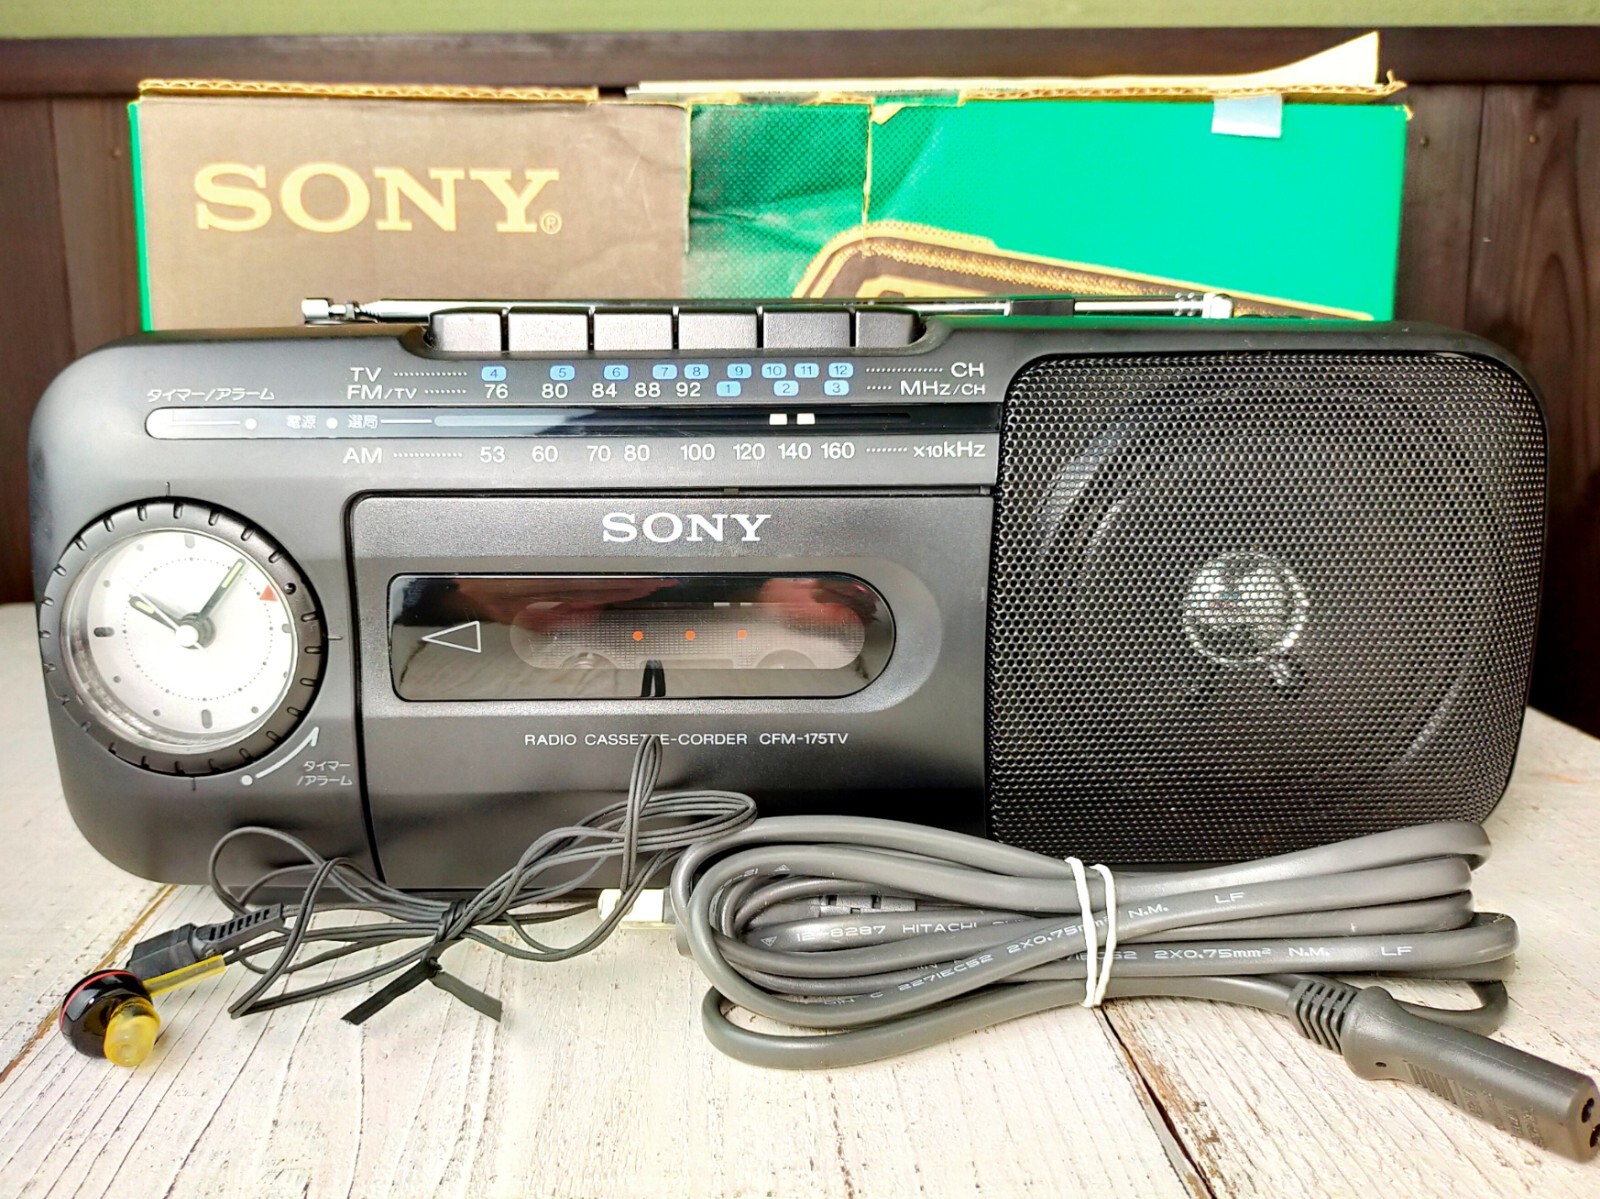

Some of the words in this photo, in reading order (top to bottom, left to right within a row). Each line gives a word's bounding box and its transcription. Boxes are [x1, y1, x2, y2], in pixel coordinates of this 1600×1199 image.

[349, 366, 382, 382] TV
[950, 362, 985, 378] CH
[147, 387, 275, 402] タイマー/アラーム
[346, 384, 418, 400] FM/TV
[483, 383, 509, 399] 76
[541, 382, 568, 399] 80
[591, 382, 618, 398] 84
[634, 382, 661, 398] 88
[675, 381, 701, 397] 92
[900, 381, 986, 397] MHz/CH
[286, 414, 317, 429] 電源
[347, 414, 378, 429] 選局
[342, 447, 383, 464] AM
[479, 446, 506, 463] 53
[531, 445, 559, 462] 60
[586, 445, 611, 462] 70
[623, 444, 650, 462] 80
[680, 443, 715, 461] 100
[732, 442, 765, 461] 120
[777, 442, 812, 460] 140
[820, 441, 855, 459] 160
[601, 512, 772, 542] SONY
[524, 733, 577, 746] RADIO
[584, 733, 748, 746] CASSEE-CORDER
[759, 732, 849, 746] CFM-175TV
[303, 760, 351, 772] タイマー
[1127, 903, 1169, 919] N.M.
[1214, 891, 1246, 905] LF
[902, 922, 977, 934] HITACHI
[1288, 946, 1330, 957] N.M.
[1380, 945, 1413, 957] LF
